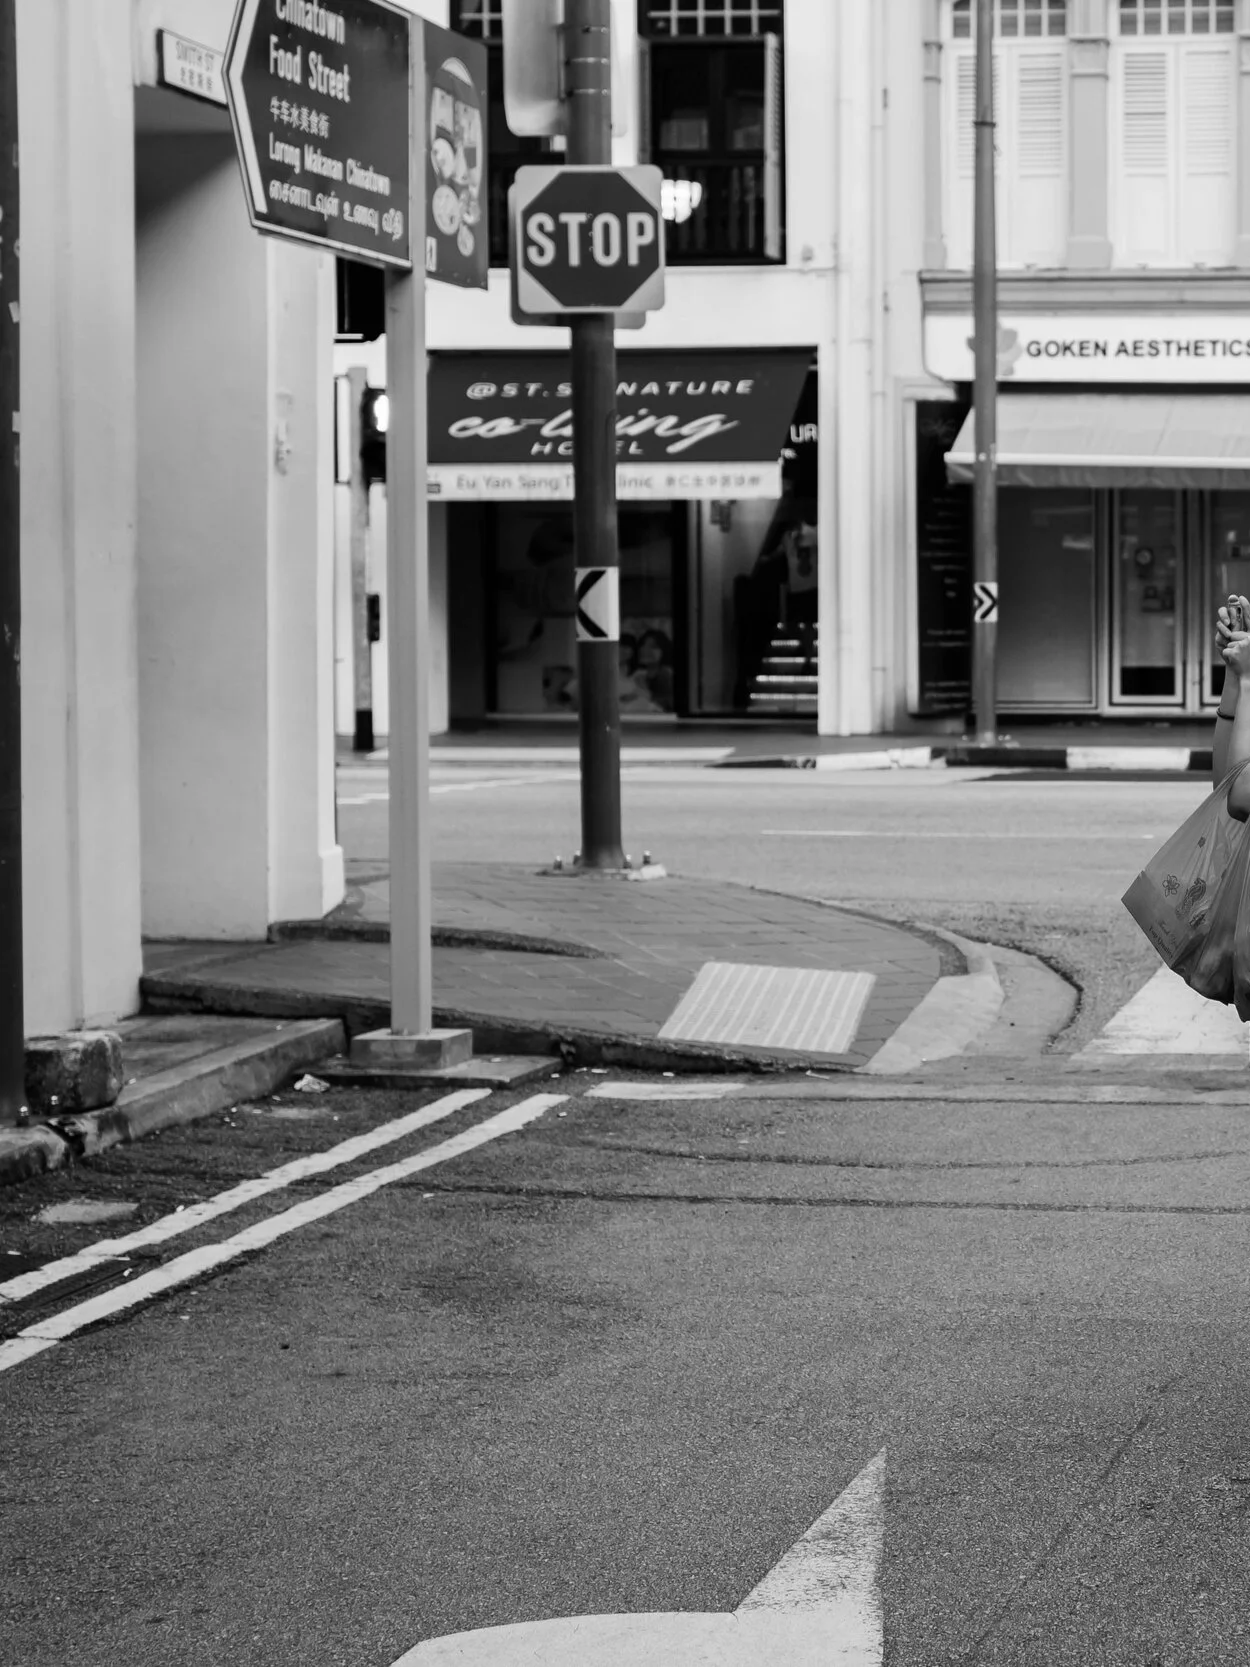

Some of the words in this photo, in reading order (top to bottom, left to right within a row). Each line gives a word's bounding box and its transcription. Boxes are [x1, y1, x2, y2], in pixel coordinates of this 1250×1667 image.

[270, 34, 302, 85] Food
[308, 51, 350, 103] Street
[269, 132, 301, 174] Lorong
[304, 144, 344, 181] Makanan
[346, 158, 390, 196] Chinatown
[526, 212, 655, 267] STOP
[1026, 340, 1108, 358] GOKEN
[466, 380, 753, 399] @ST.SNATURE
[448, 408, 741, 454] co-ling
[618, 475, 653, 489] linic
